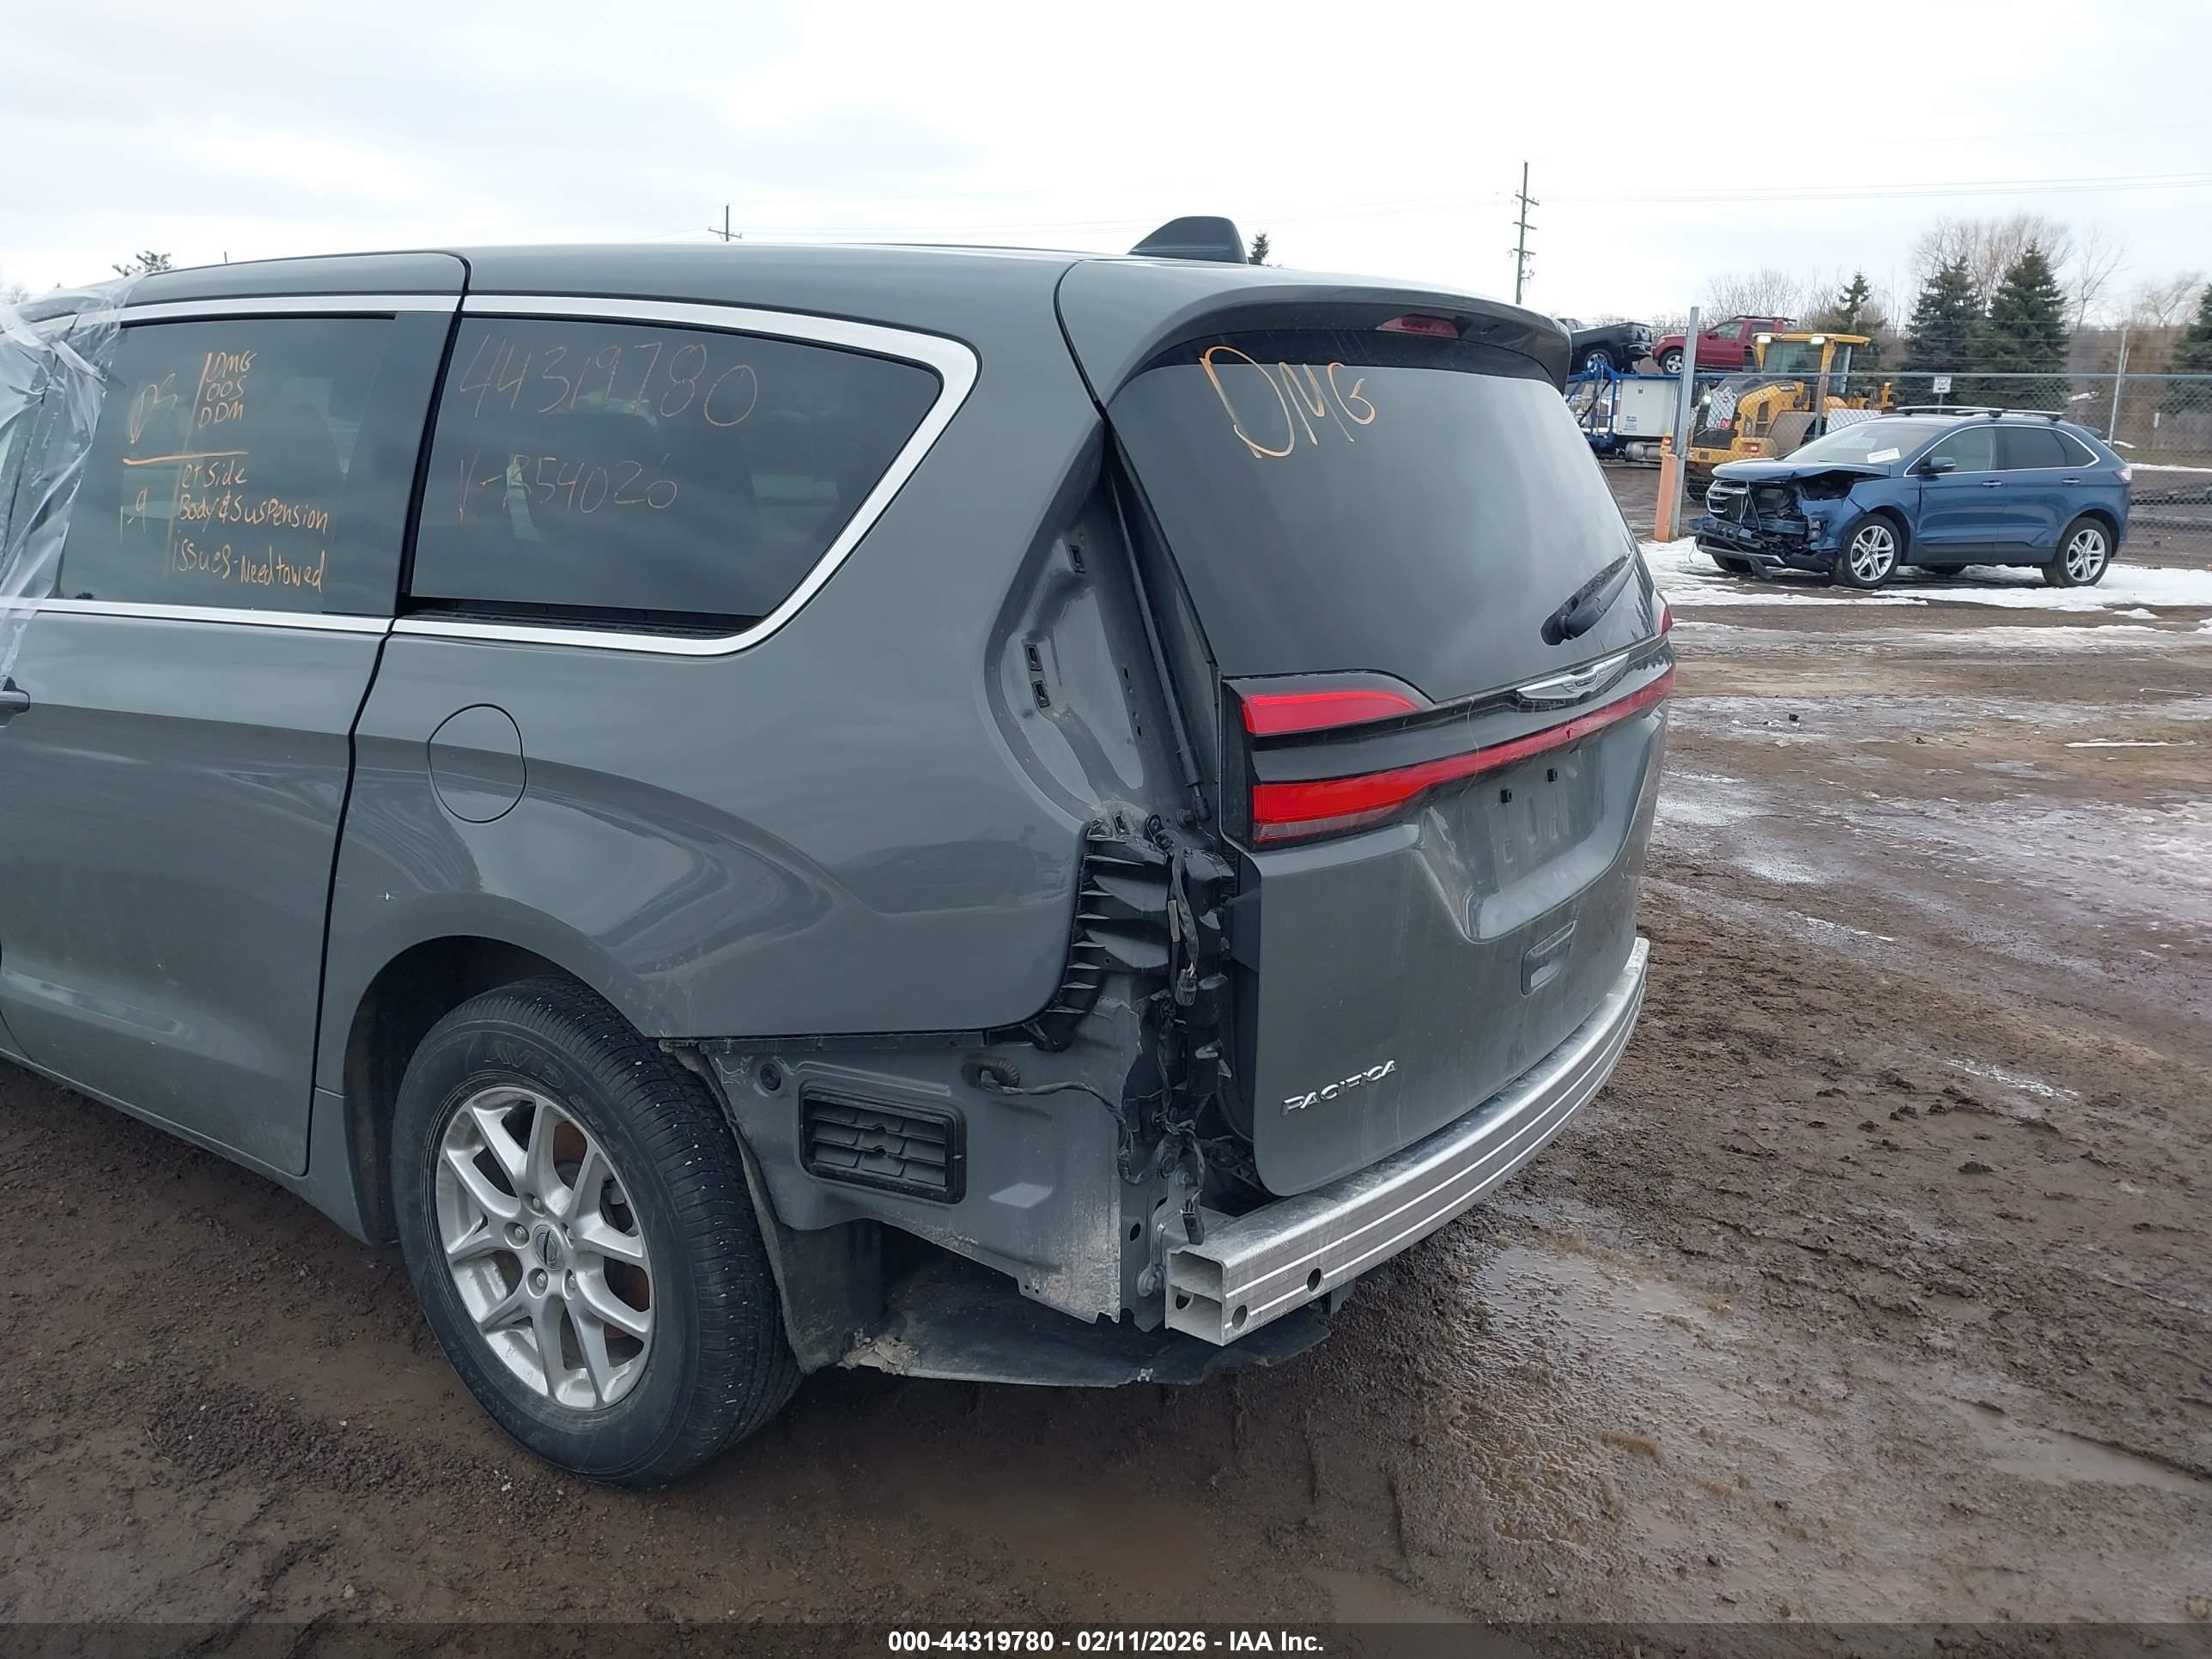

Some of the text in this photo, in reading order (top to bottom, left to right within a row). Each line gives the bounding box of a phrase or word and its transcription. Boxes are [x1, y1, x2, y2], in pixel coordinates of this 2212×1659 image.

[459, 333, 758, 427] 44319780
[1199, 345, 1376, 459] DMG
[1280, 1059, 1396, 1116] PACIFICA
